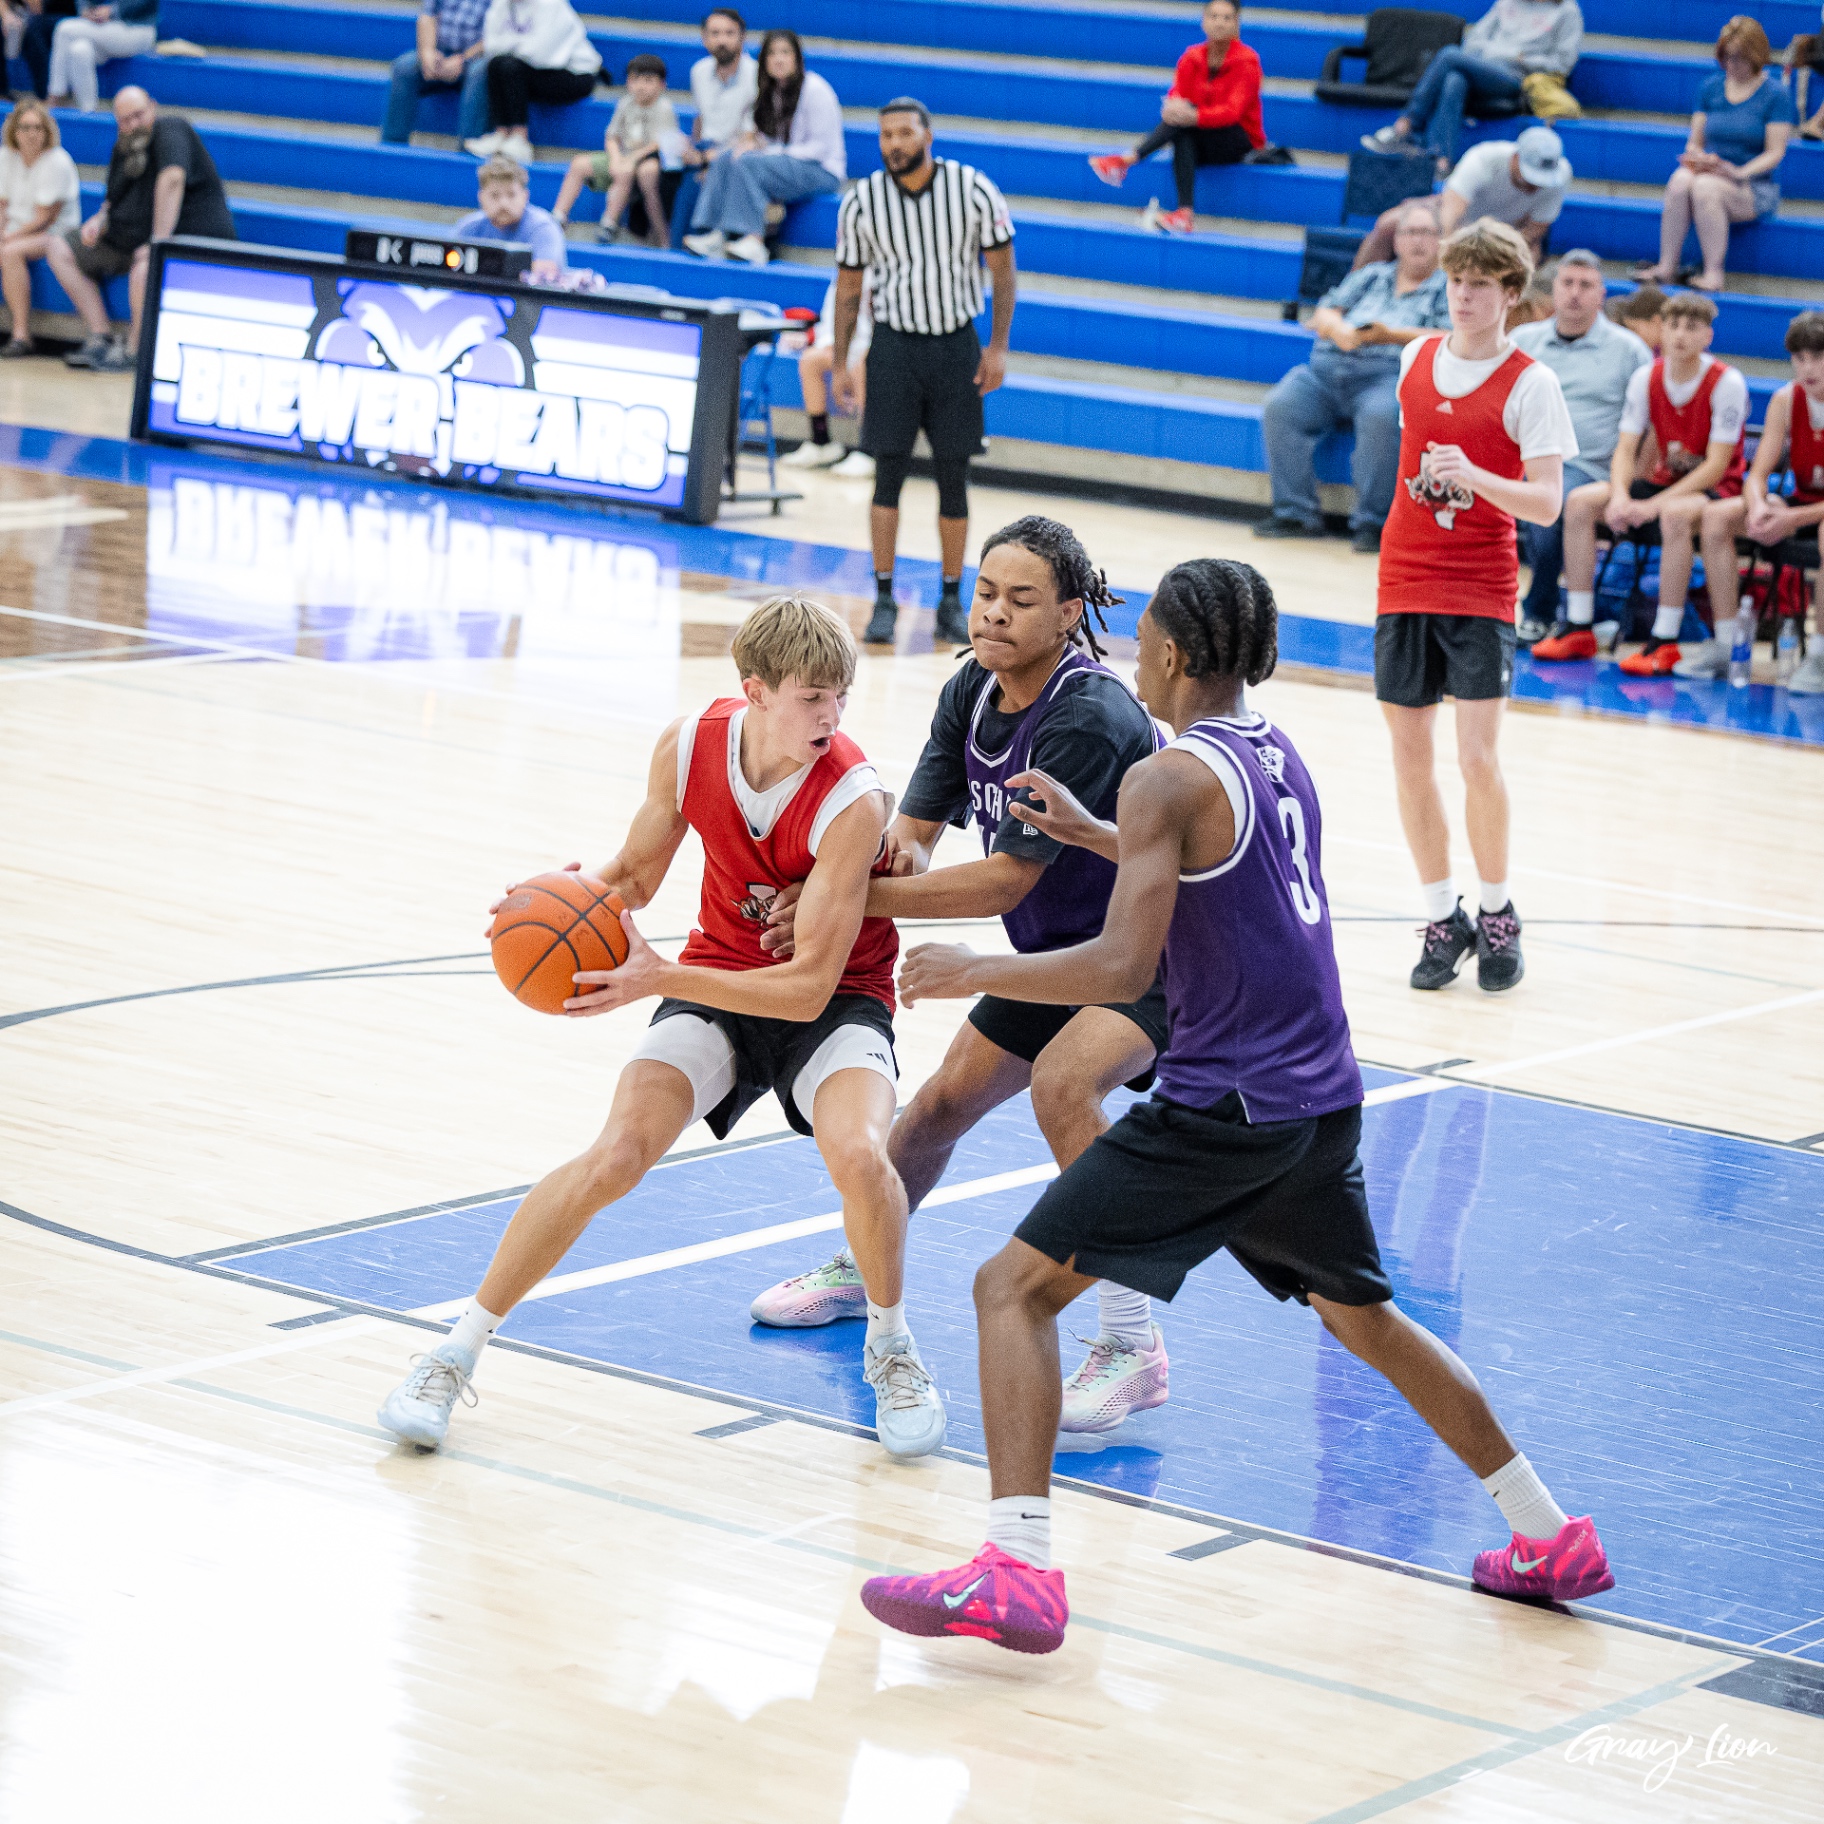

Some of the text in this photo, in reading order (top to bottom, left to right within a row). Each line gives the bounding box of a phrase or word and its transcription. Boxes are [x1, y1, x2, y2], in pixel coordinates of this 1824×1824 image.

[177, 343, 669, 491] BREWER BEARS
[967, 778, 1012, 822] SCH
[1277, 796, 1321, 925] 3
